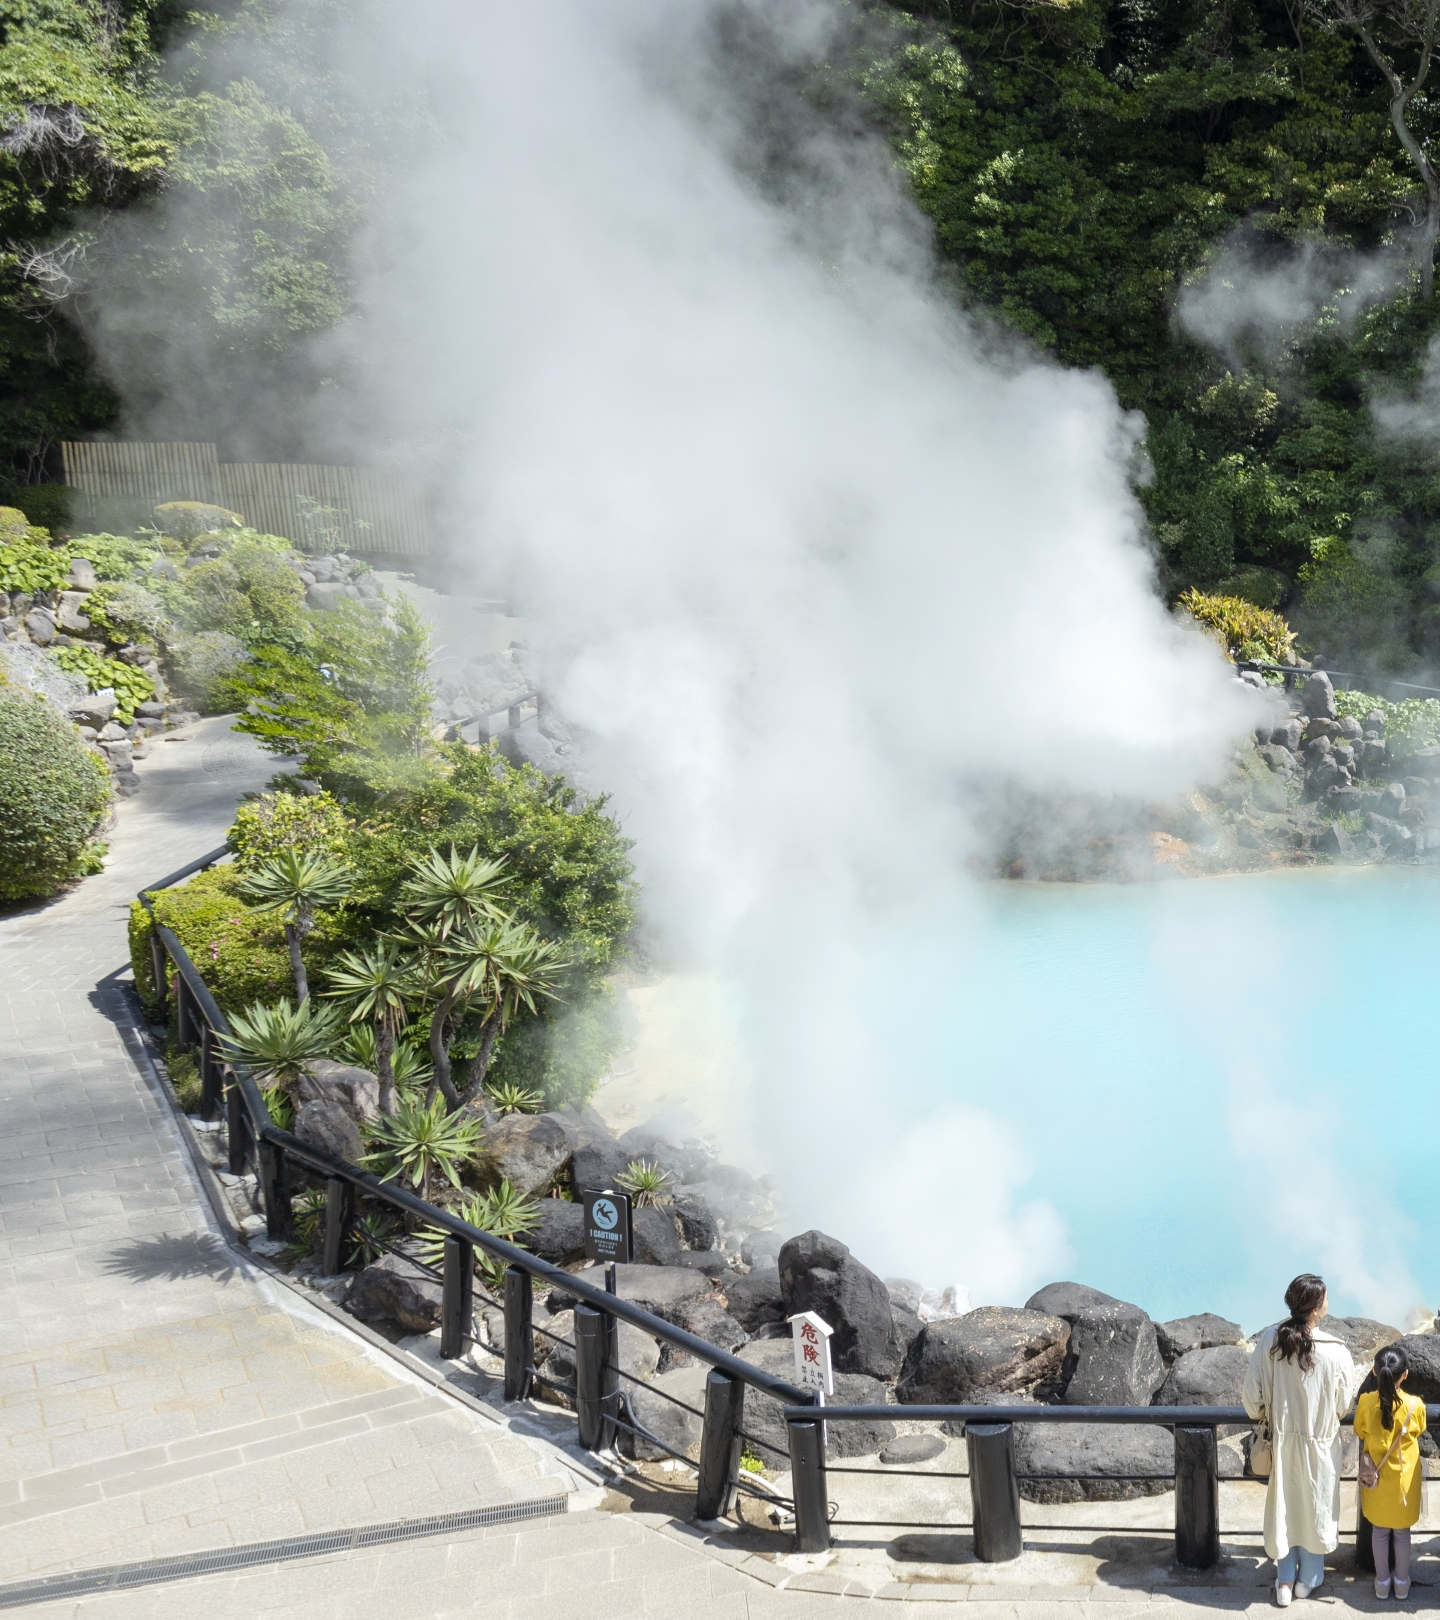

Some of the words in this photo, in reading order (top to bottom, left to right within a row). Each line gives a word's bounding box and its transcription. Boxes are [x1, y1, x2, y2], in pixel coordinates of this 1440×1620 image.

[593, 1230, 619, 1241] CAUTION
[800, 1321, 821, 1367] 危険
[801, 1365, 808, 1384] 禁止
